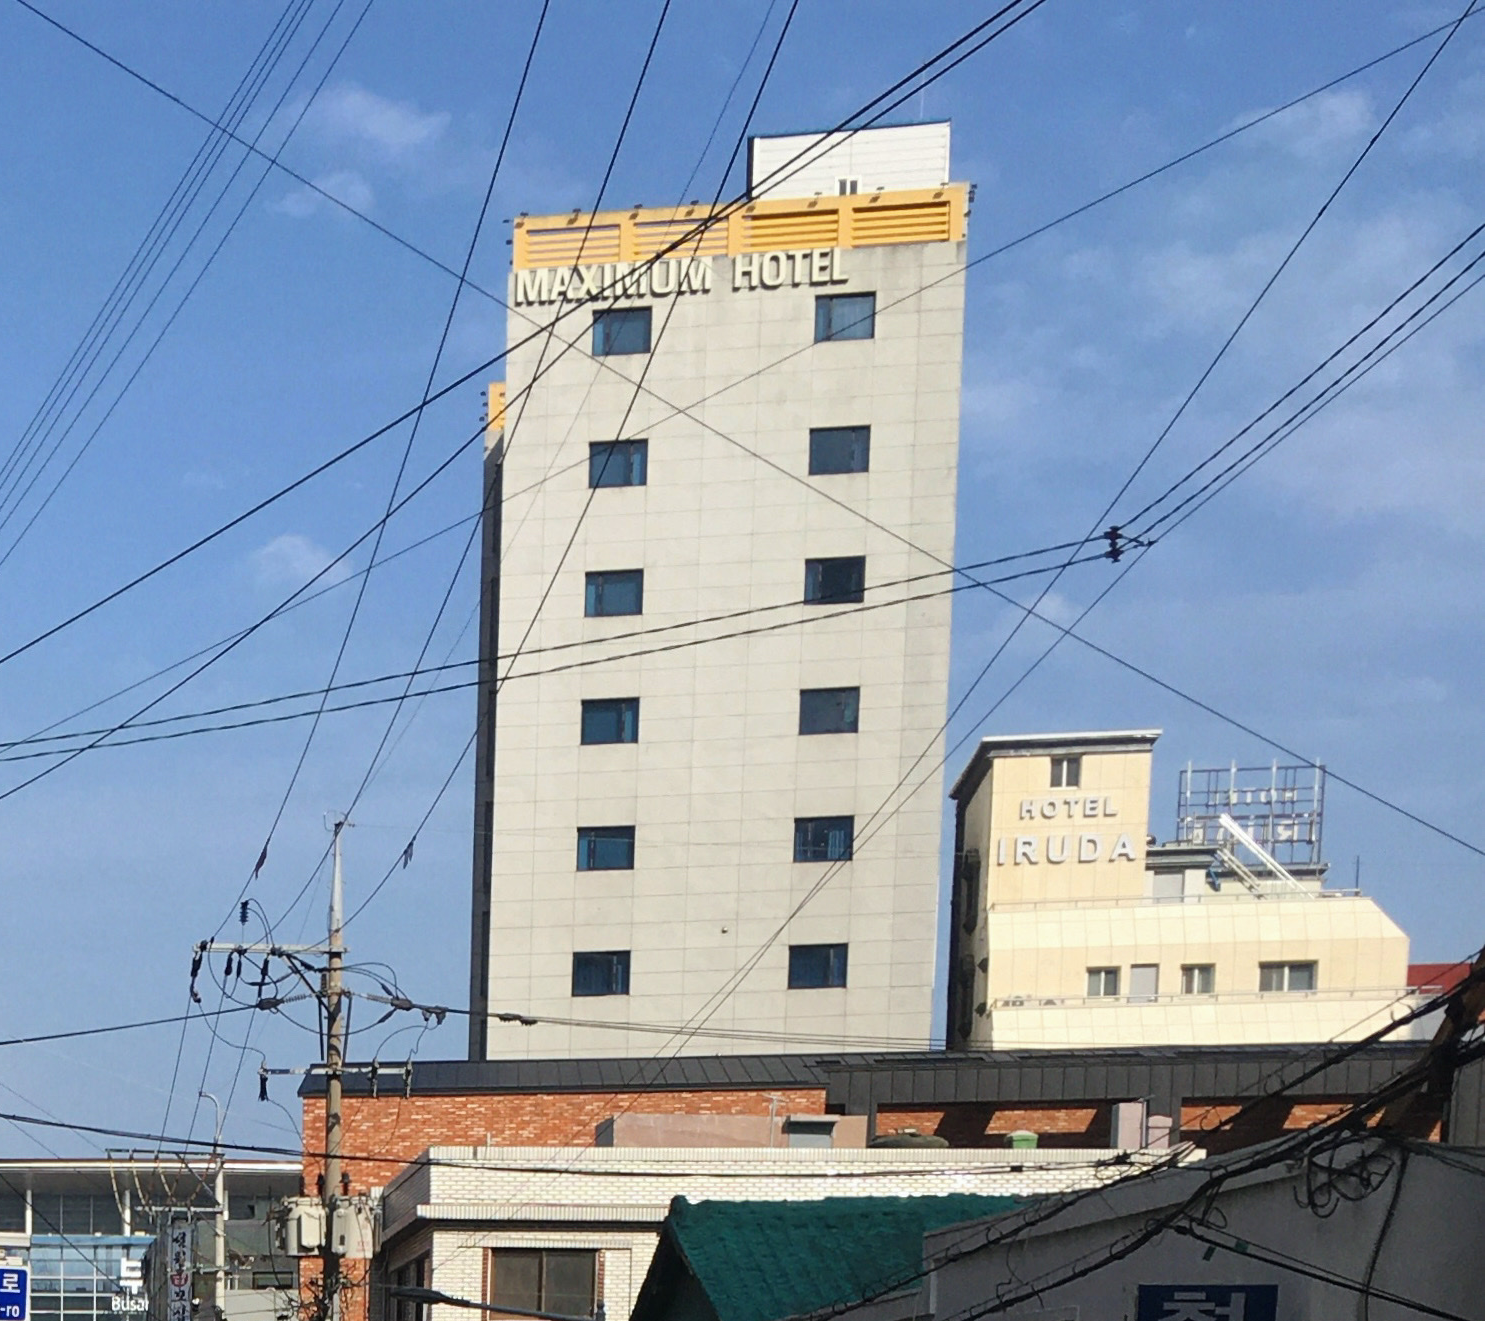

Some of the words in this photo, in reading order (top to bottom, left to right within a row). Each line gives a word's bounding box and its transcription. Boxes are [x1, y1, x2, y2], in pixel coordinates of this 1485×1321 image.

[515, 254, 713, 307] MAXIMUM
[732, 247, 849, 292] HOTEL
[1019, 796, 1118, 820] HOTEL
[997, 832, 1136, 866] IRUDA
